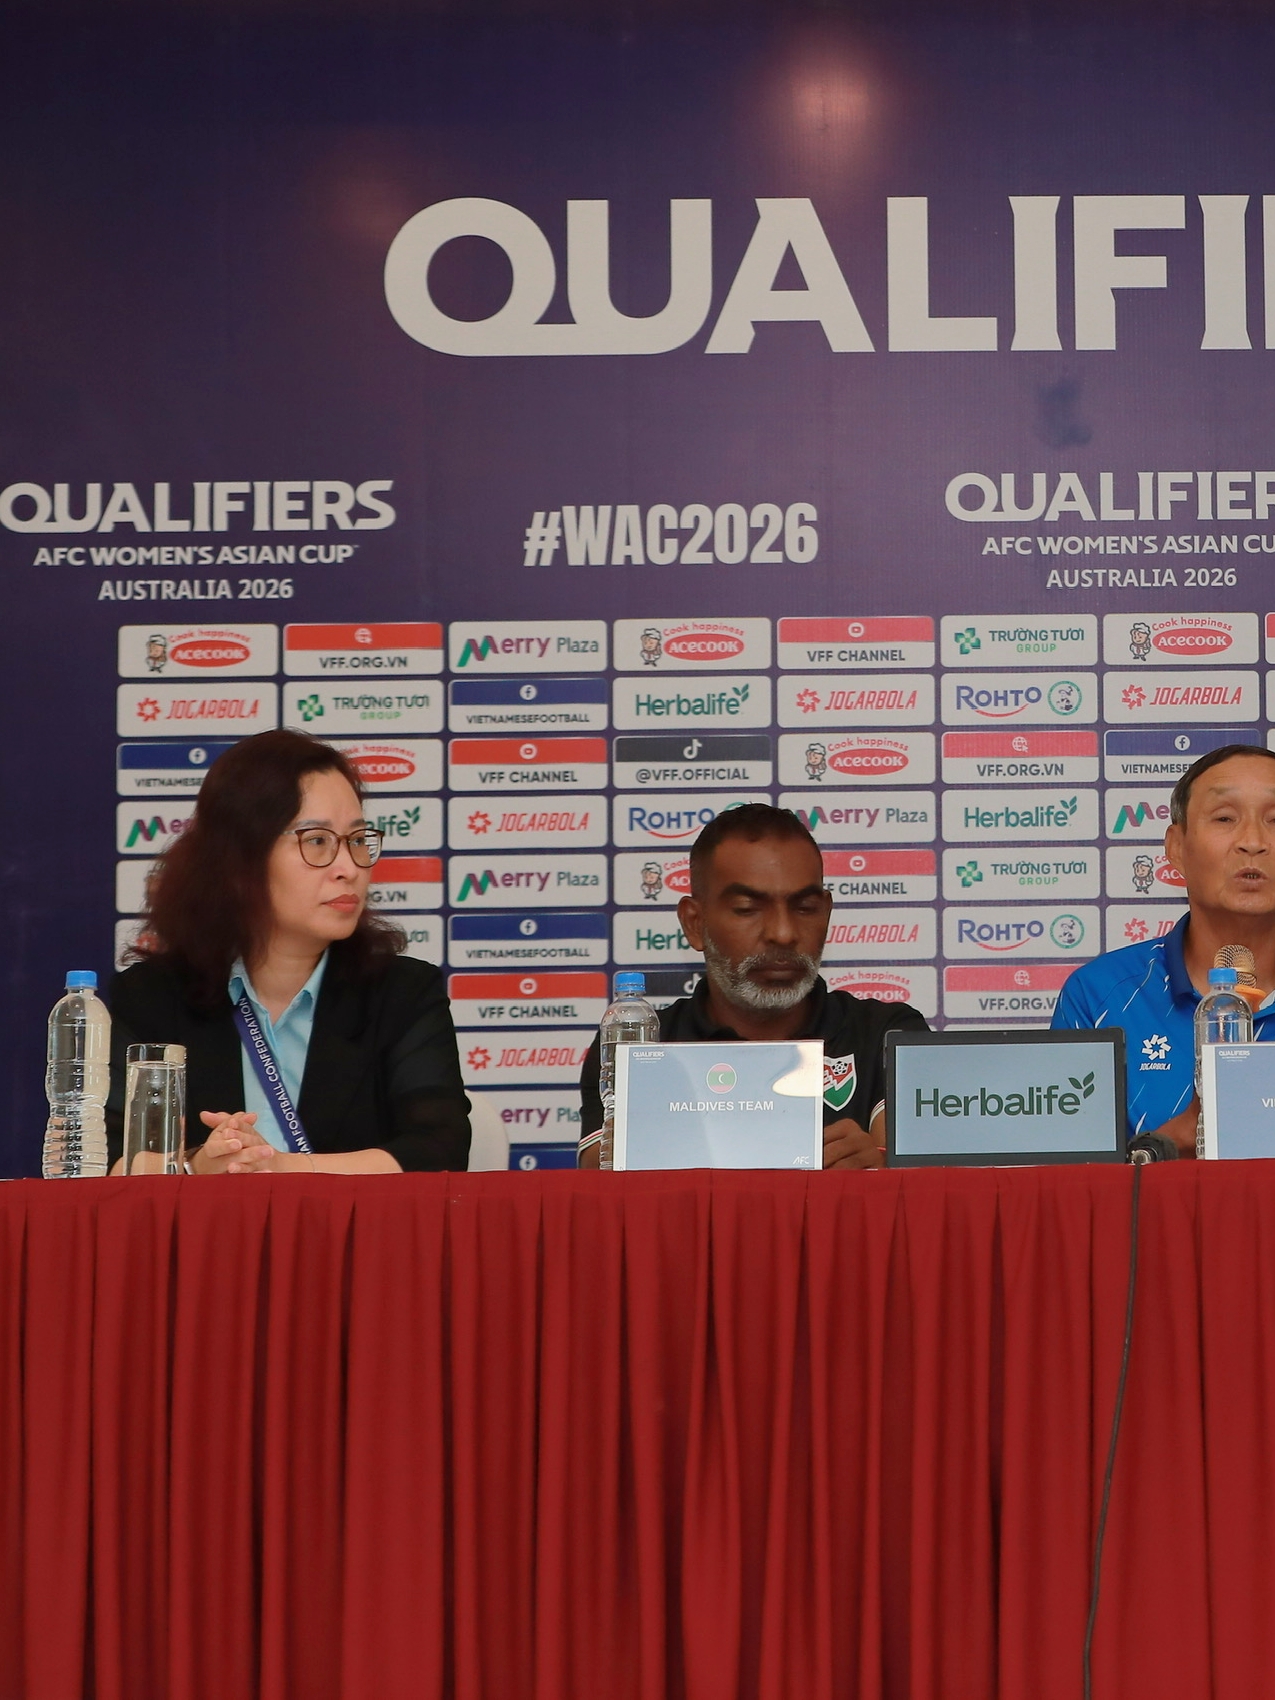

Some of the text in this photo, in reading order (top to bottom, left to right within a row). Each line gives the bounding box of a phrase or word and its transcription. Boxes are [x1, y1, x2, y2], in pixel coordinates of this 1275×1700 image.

[0, 480, 396, 533] QUALIFIERS
[523, 503, 817, 567] #WAC2026
[982, 537, 1032, 555] AFC
[1037, 536, 1157, 555] WOMEN'S
[1161, 536, 1238, 555] ASIAN
[33, 546, 85, 567] AFC
[90, 546, 212, 567] WOMEN'S
[216, 546, 293, 567] ASIAN
[1046, 568, 1237, 587] AUSTRALIA 2026
[98, 579, 293, 600] AUSTRALIA 2026
[663, 622, 744, 638] Cook happiness
[1152, 617, 1232, 632] Cook happiness
[989, 626, 1084, 642] TRƯỜNG TƯƠI
[456, 636, 598, 667] Merry Plaza
[807, 649, 905, 662] VFF CHANNEL
[1016, 644, 1056, 653] GROUP
[320, 656, 407, 669] VFF.ORG.VN
[332, 694, 429, 709] TRƯỜNG TƯƠI
[635, 691, 740, 716] Herbalife
[824, 690, 917, 711] JOGARBOLA
[956, 686, 1042, 710] ROHTO
[1149, 687, 1242, 705] JOGARBOLA
[166, 699, 259, 720] JOGARBOLA
[360, 712, 401, 720] GROUP
[466, 713, 590, 724] VIETNAMESEFOOTBALL
[828, 737, 909, 752] Cook happiness
[479, 771, 577, 783] VFF CHANNEL
[636, 768, 748, 783] @VFF.OFFICIAL
[976, 763, 1063, 776] VFF.ORG.VN
[496, 812, 589, 832] JOGARBOLA
[886, 808, 927, 823] Plaza
[964, 806, 1068, 827] Herbalife
[991, 859, 1087, 875] TRƯỜNG TƯƠI
[457, 869, 598, 901] Merry Plaza
[1019, 876, 1058, 886] GROUP
[827, 924, 918, 944] JOGARBOLA
[958, 919, 1044, 943] ROHTO
[466, 948, 590, 958] VIETNAMESEFOOTBALL
[479, 1006, 577, 1018] VFF CHANNEL
[239, 997, 299, 1136] FOOTBALL CONFEDERATION
[669, 1101, 774, 1112] MALDIVES TEAM
[915, 1084, 1081, 1118] Herbalife
